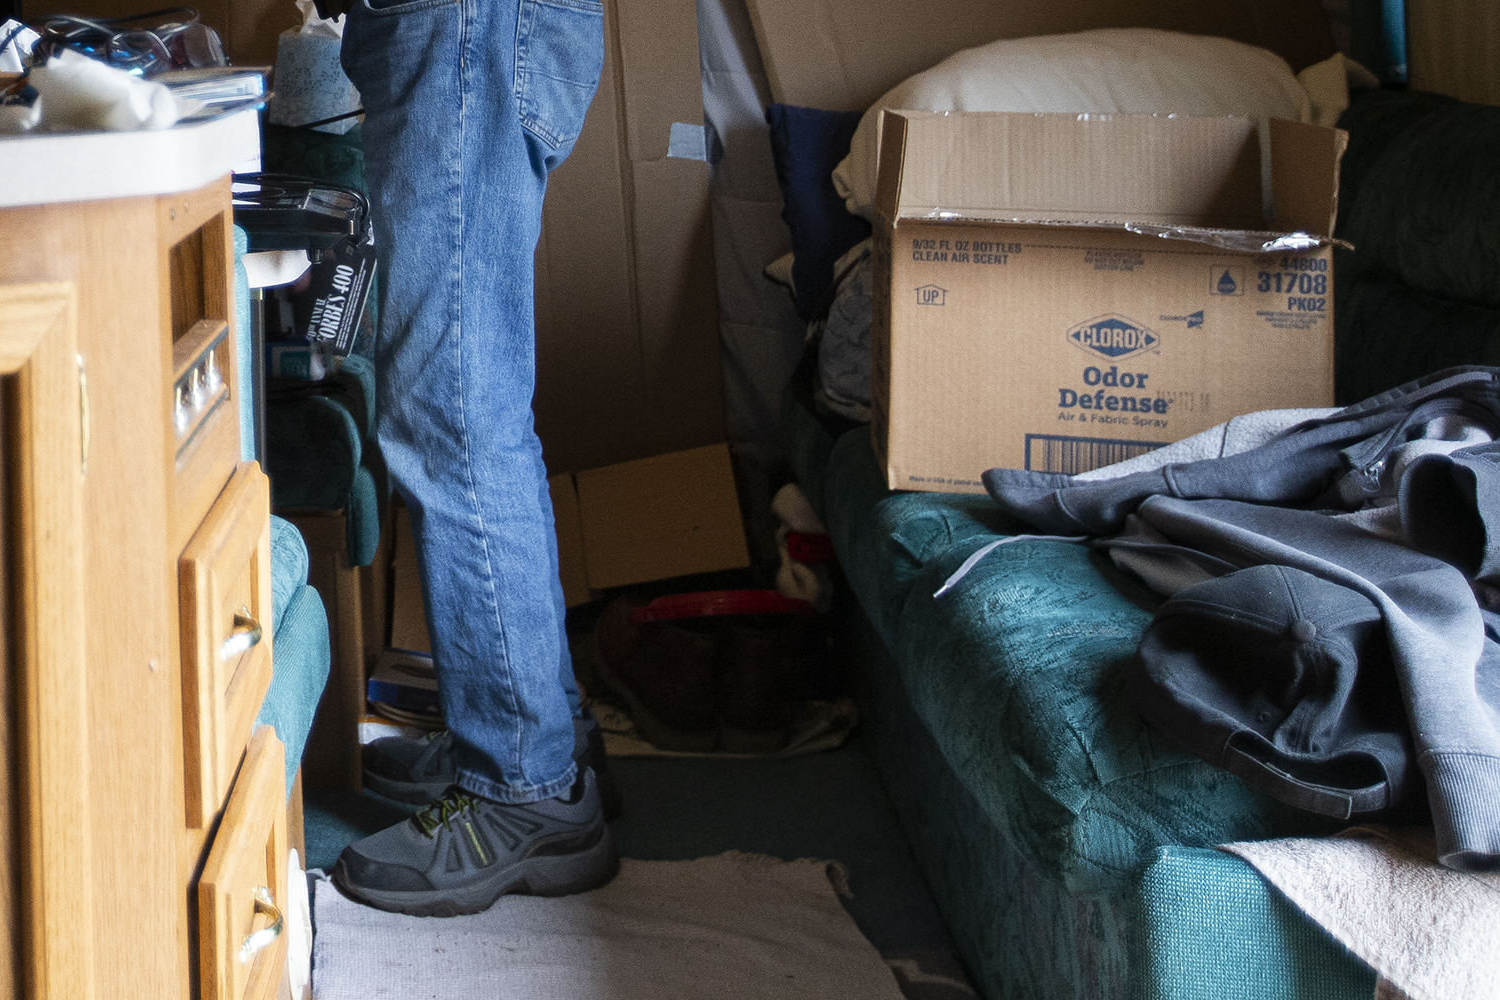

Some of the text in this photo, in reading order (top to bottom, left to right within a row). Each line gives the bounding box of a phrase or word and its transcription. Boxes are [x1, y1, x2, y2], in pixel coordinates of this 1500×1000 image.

[912, 240, 1022, 253] 9/32 FL OZ BOTTLES
[912, 251, 1008, 265] CLEAN AIR SCENT
[332, 264, 354, 294] 400
[1257, 271, 1327, 295] 31708
[923, 290, 939, 302] UP
[1288, 297, 1326, 311] PK02
[1079, 326, 1147, 349] CLOROX
[1083, 366, 1148, 389] Odor
[1058, 388, 1169, 413] Defense
[1058, 411, 1168, 428] Air & Fabric Spray
